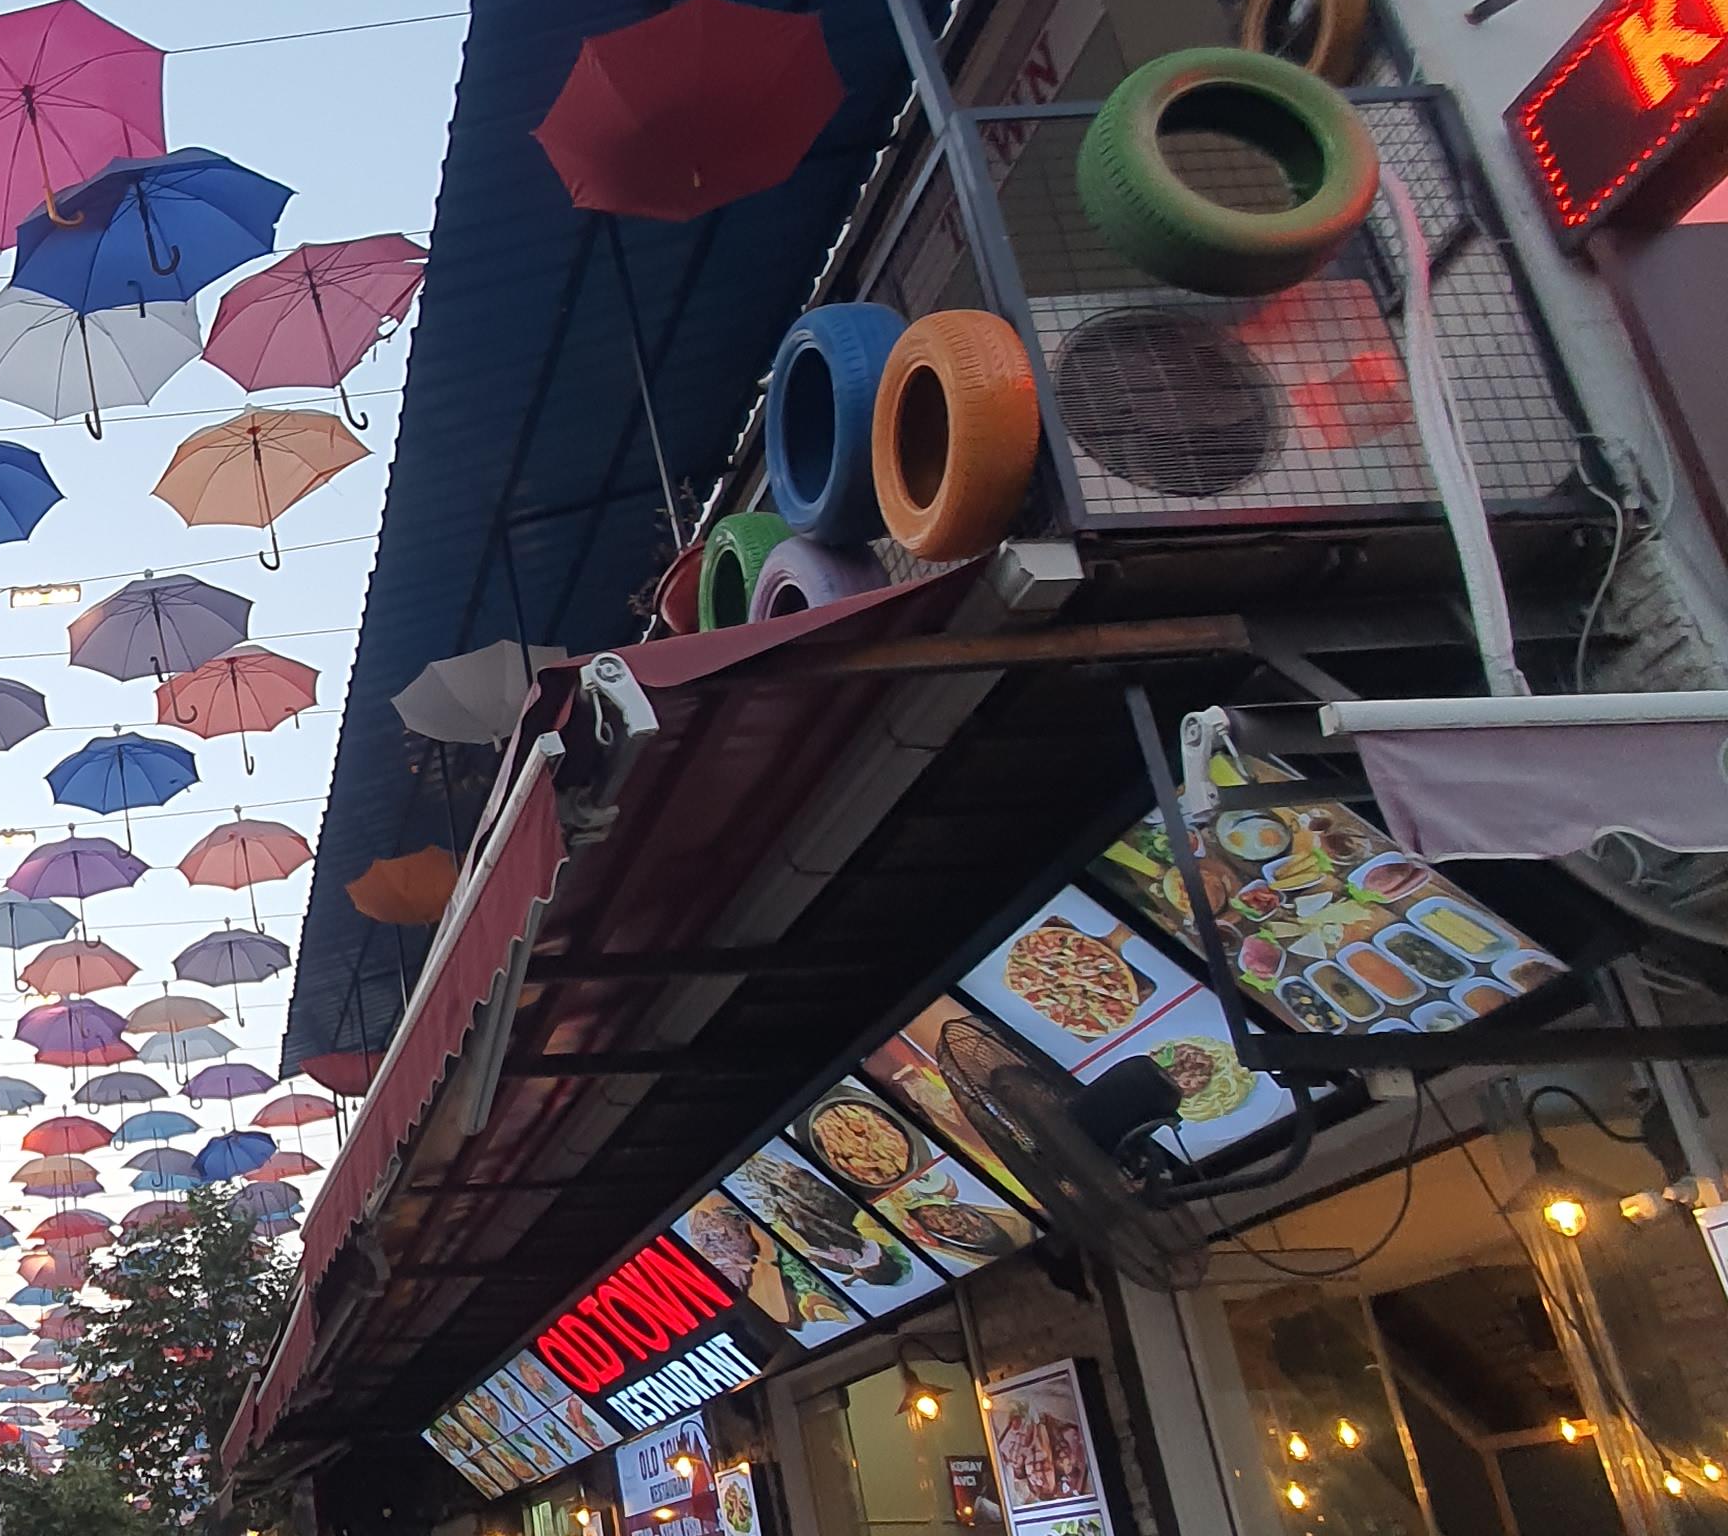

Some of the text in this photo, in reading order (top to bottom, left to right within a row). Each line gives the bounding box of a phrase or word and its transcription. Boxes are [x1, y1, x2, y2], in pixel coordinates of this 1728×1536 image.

[537, 1235, 734, 1393] OLD TOWN
[606, 1332, 762, 1432] RESTAURANT
[638, 1445, 660, 1480] OLD
